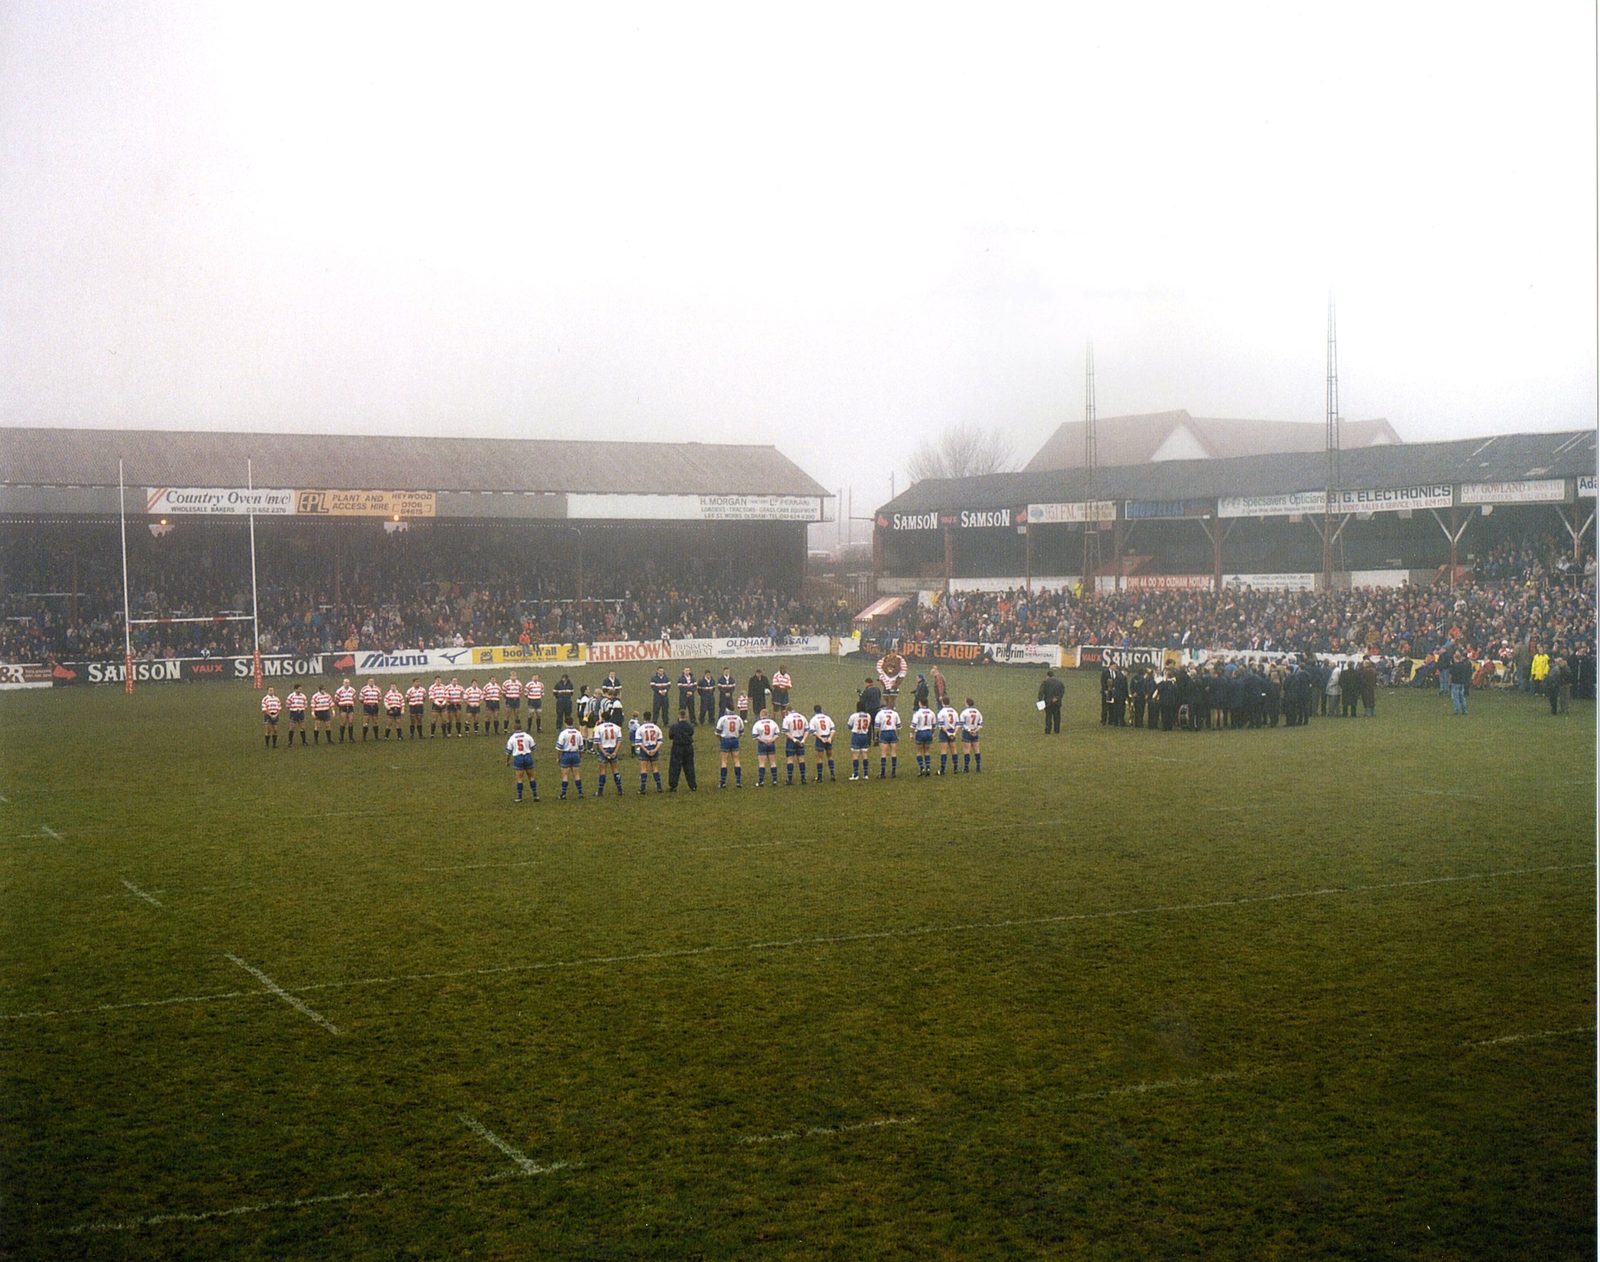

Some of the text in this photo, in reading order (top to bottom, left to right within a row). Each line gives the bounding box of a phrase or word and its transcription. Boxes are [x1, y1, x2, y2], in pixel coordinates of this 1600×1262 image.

[166, 490, 223, 506] Country
[228, 491, 262, 504] Oven
[332, 494, 361, 502] PLANT
[1357, 486, 1451, 502] ELECTRONICS
[709, 498, 747, 506] MORGAN
[1243, 493, 1325, 508] Specsavers Opticians
[370, 503, 389, 511] HIRE
[893, 512, 938, 530] SAMSON
[961, 509, 1010, 527] SAMSON
[1166, 578, 1188, 587] OLDHAM
[726, 639, 768, 648] OLDHAM
[995, 647, 1024, 661] Pilgrim
[1102, 648, 1161, 668] SAMSON
[192, 664, 223, 673] VAUX
[793, 719, 803, 731] 10
[820, 720, 826, 731] 6
[886, 715, 892, 726] 2
[924, 715, 929, 726] 1
[604, 729, 615, 740] 11
[644, 730, 656, 741] 12
[764, 725, 770, 736] 9
[517, 739, 524, 751] 5
[570, 735, 576, 746] 4
